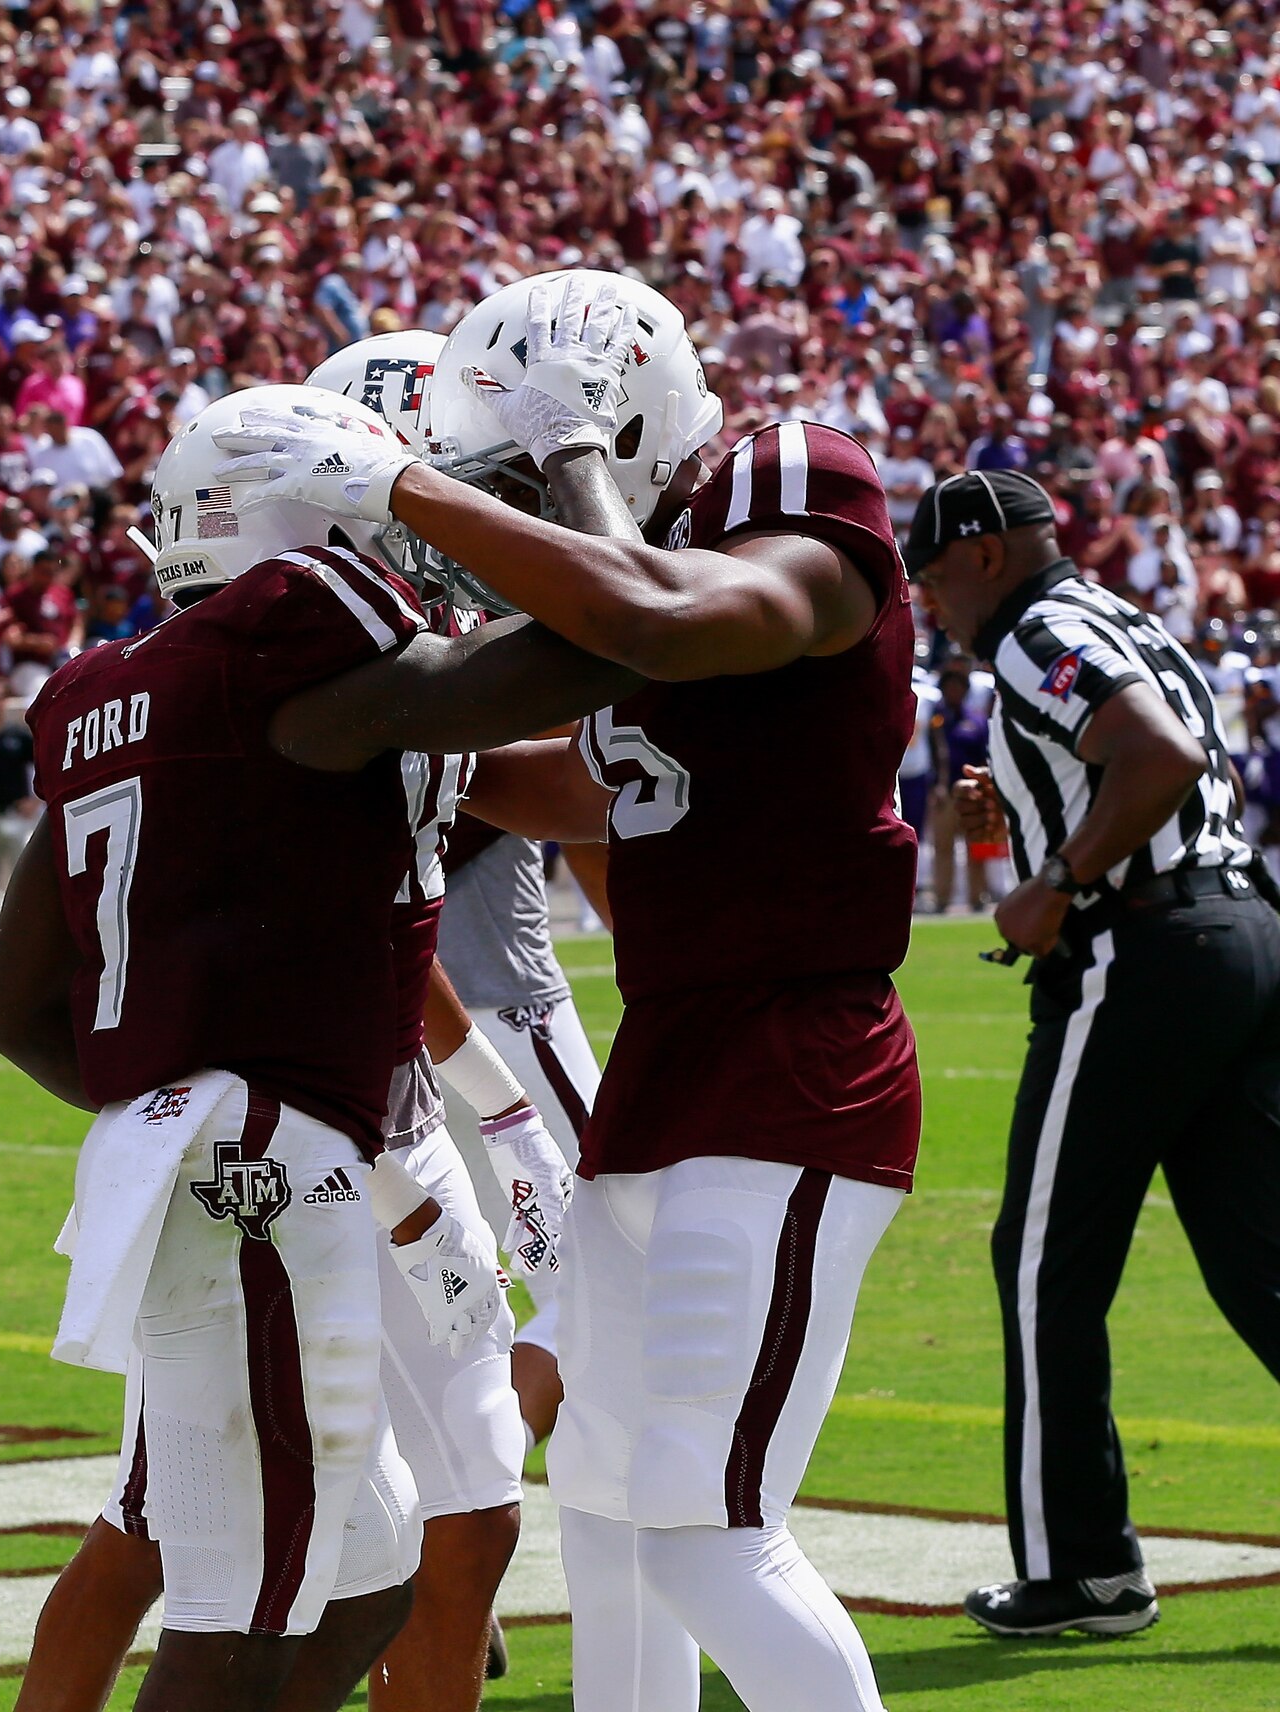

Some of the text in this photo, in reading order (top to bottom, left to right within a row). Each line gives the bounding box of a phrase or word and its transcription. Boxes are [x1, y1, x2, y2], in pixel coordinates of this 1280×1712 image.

[592, 379, 609, 412] adidas
[312, 464, 351, 474] adidas
[169, 504, 183, 542] 7
[157, 560, 207, 584] TEXAS A&M
[61, 691, 151, 772] FORD
[62, 775, 143, 1034] 7
[303, 1188, 361, 1204] adidas
[441, 1268, 455, 1305] adidas
